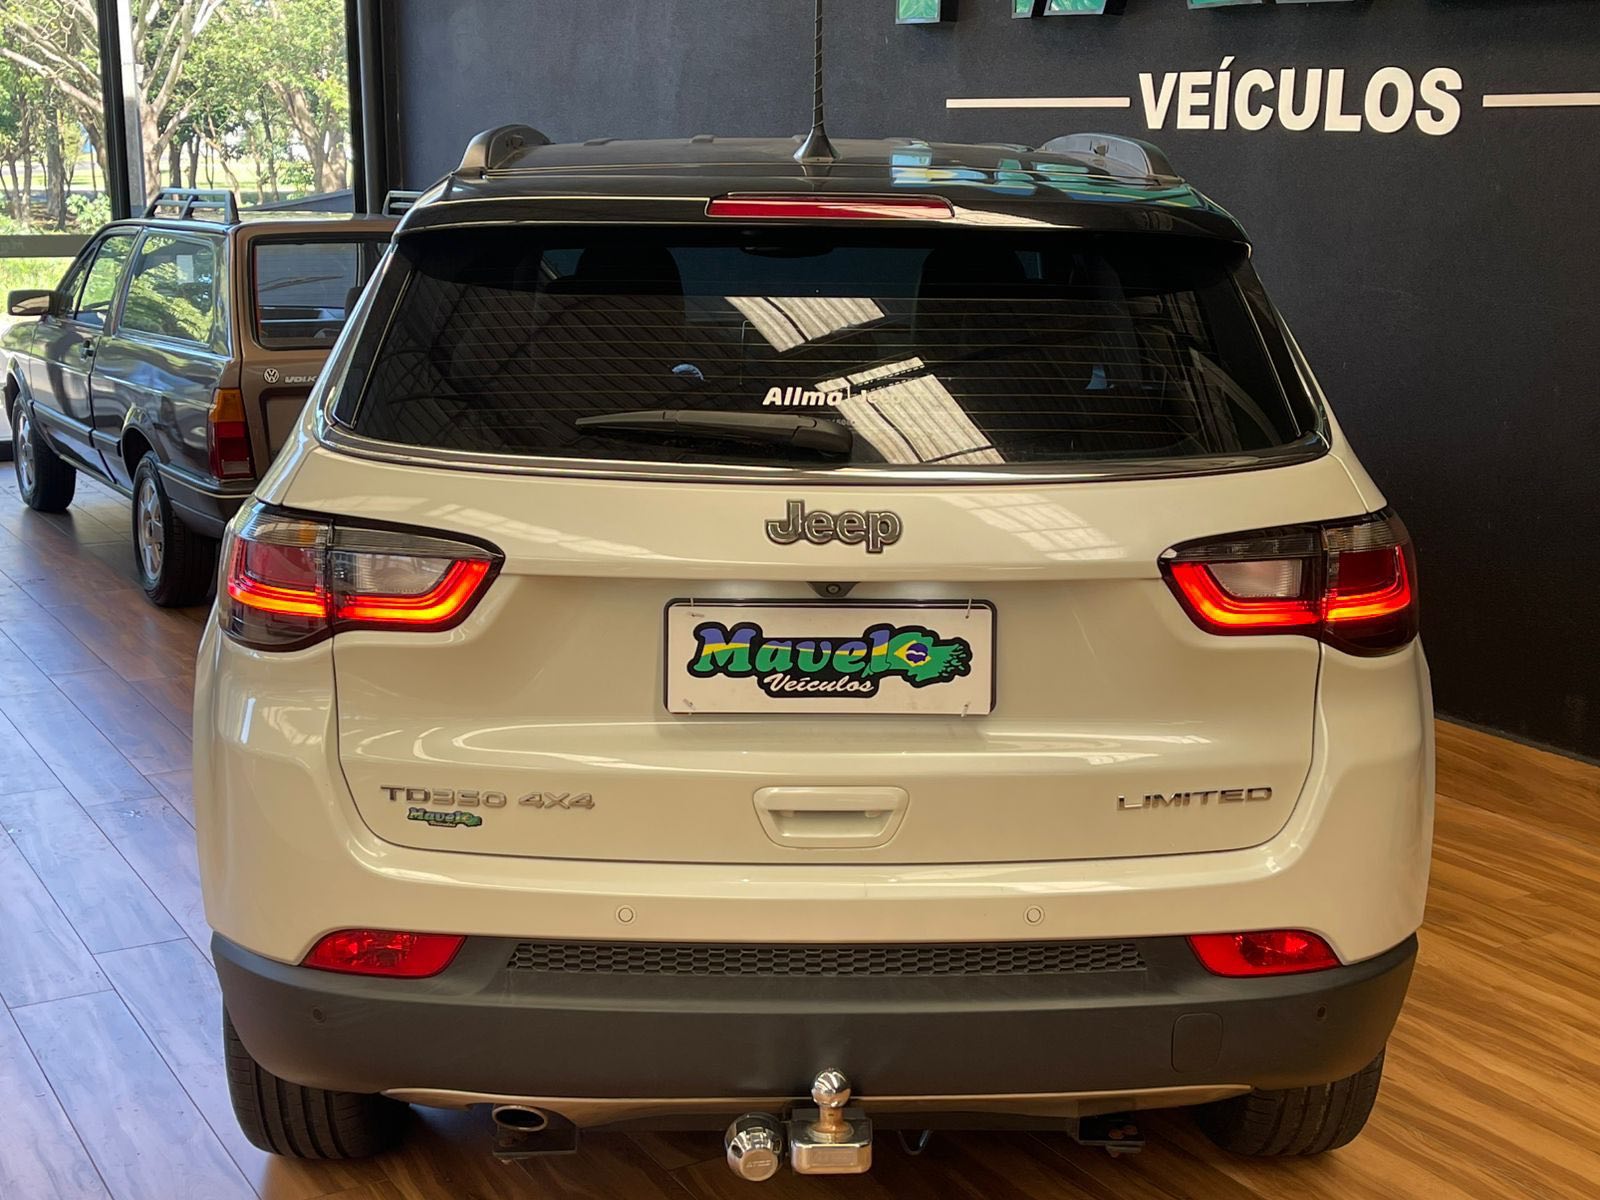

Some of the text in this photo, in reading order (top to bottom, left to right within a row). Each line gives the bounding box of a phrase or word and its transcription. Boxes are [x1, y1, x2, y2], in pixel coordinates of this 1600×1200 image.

[1138, 56, 1463, 136] VEÍCULOS
[765, 499, 904, 553] Jeep
[380, 785, 507, 809] TD350
[1116, 787, 1273, 811] LIMITED
